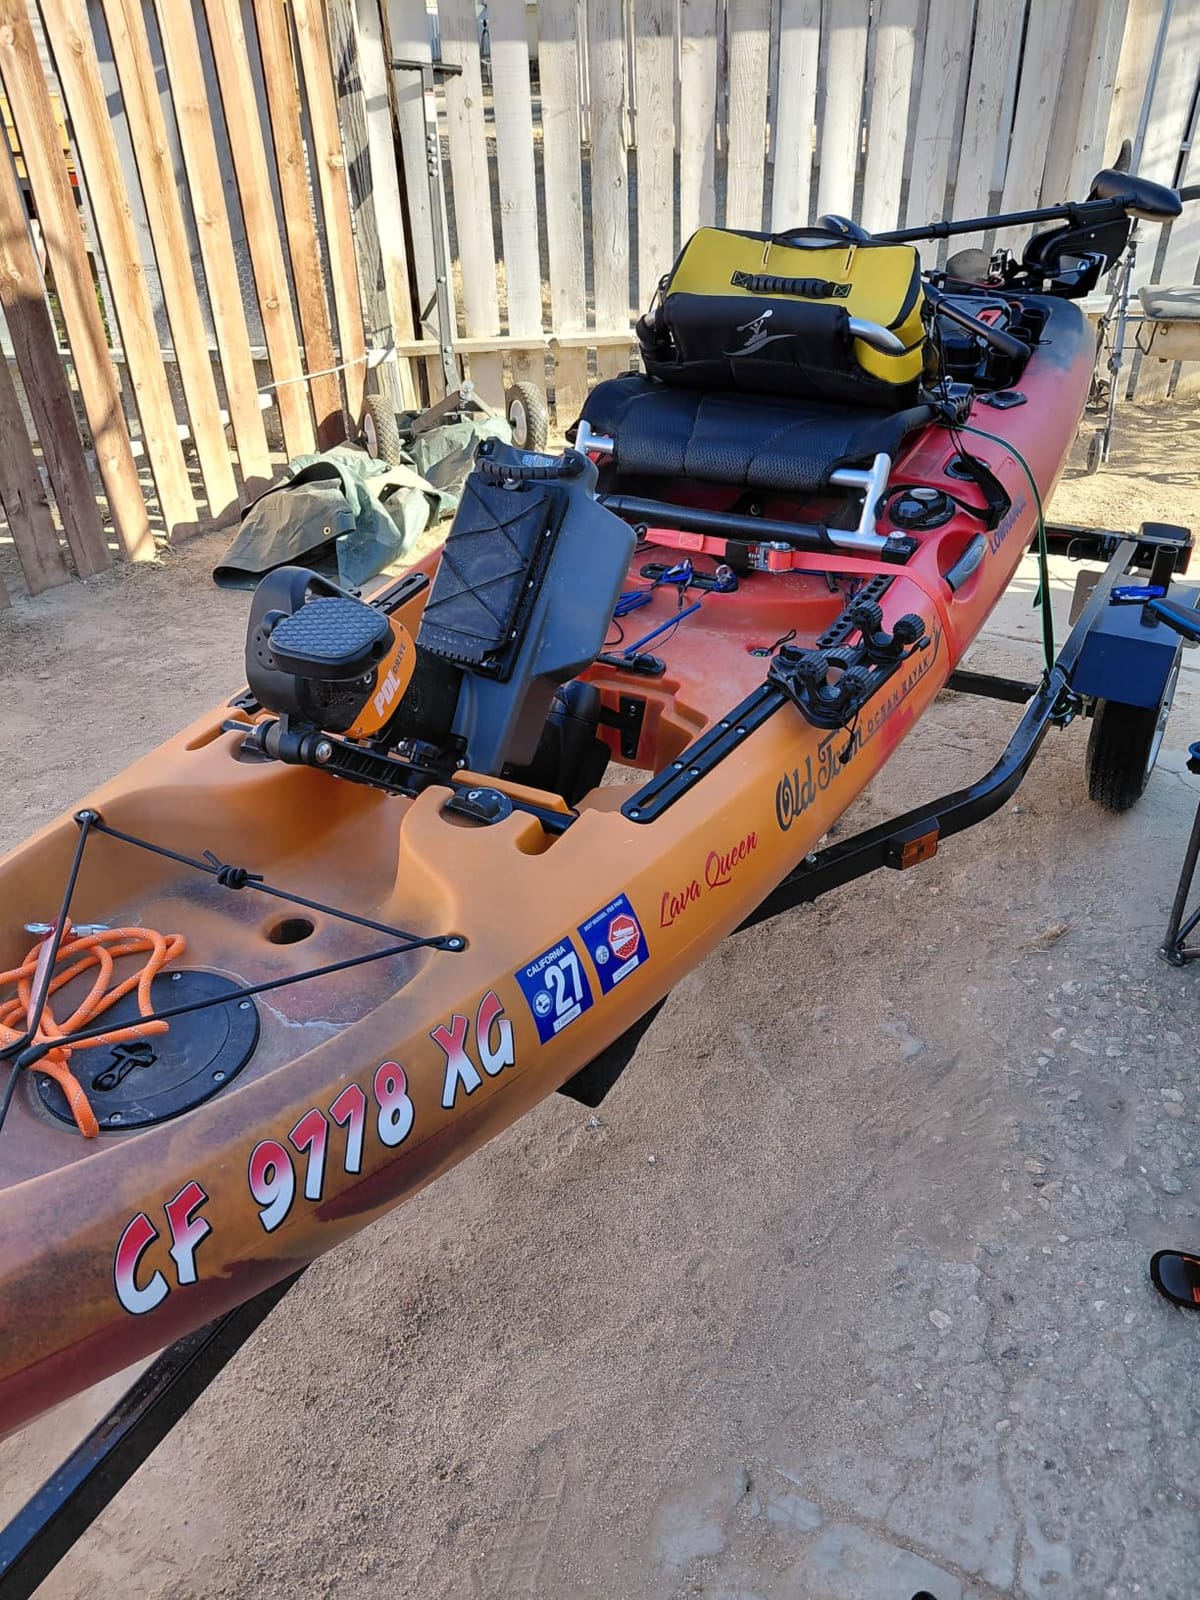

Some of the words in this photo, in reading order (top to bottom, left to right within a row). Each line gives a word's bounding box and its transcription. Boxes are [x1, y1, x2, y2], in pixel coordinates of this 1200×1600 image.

[373, 670, 401, 717] PDL
[392, 642, 406, 674] DRIVE
[775, 754, 817, 832] Old
[867, 689, 899, 734] OCEAN
[902, 655, 930, 696] KAYAK
[660, 879, 701, 928] Lava
[705, 831, 758, 891] Queen
[526, 945, 566, 978] CALIFORNIA
[544, 950, 584, 1017] 27
[113, 1180, 213, 1315] CF
[247, 1061, 415, 1233] 9778
[430, 990, 516, 1109] XG
